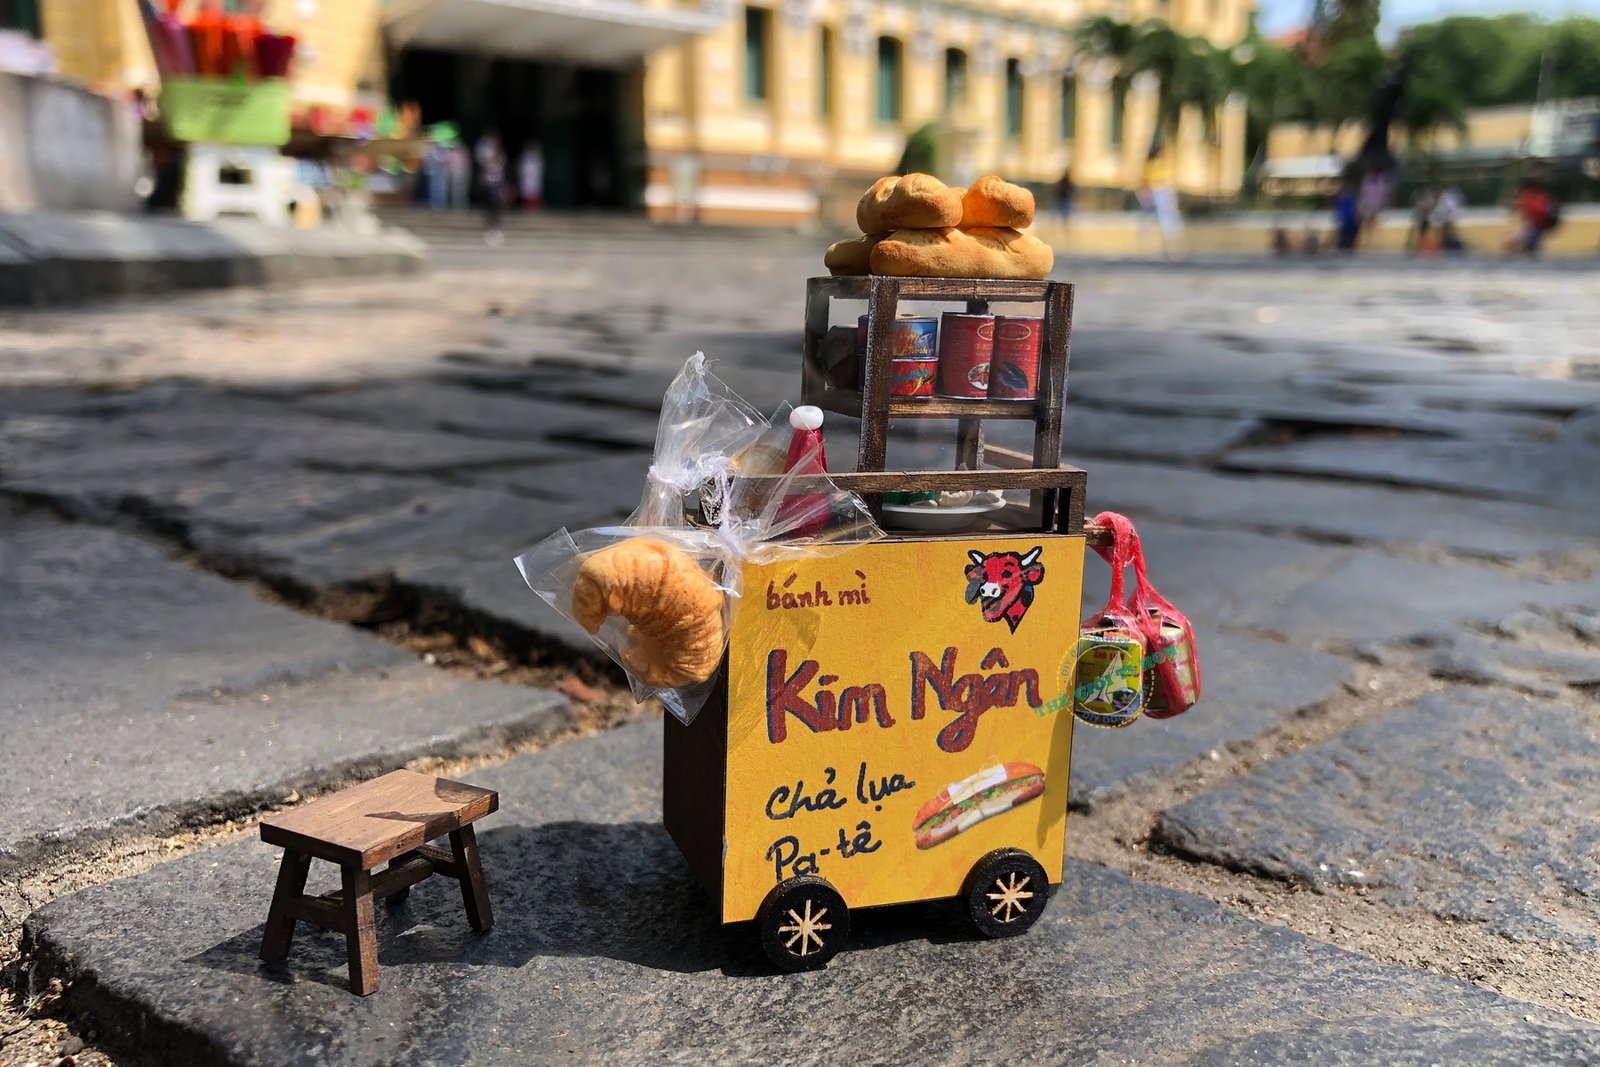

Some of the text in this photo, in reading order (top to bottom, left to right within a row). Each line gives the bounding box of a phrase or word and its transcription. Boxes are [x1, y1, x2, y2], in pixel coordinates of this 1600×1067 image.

[766, 569, 871, 610] bánh mì
[766, 649, 896, 744] Kim
[909, 646, 1043, 753] Ngân
[765, 762, 915, 820] Chả lụa
[765, 820, 882, 883] Pa-tê
